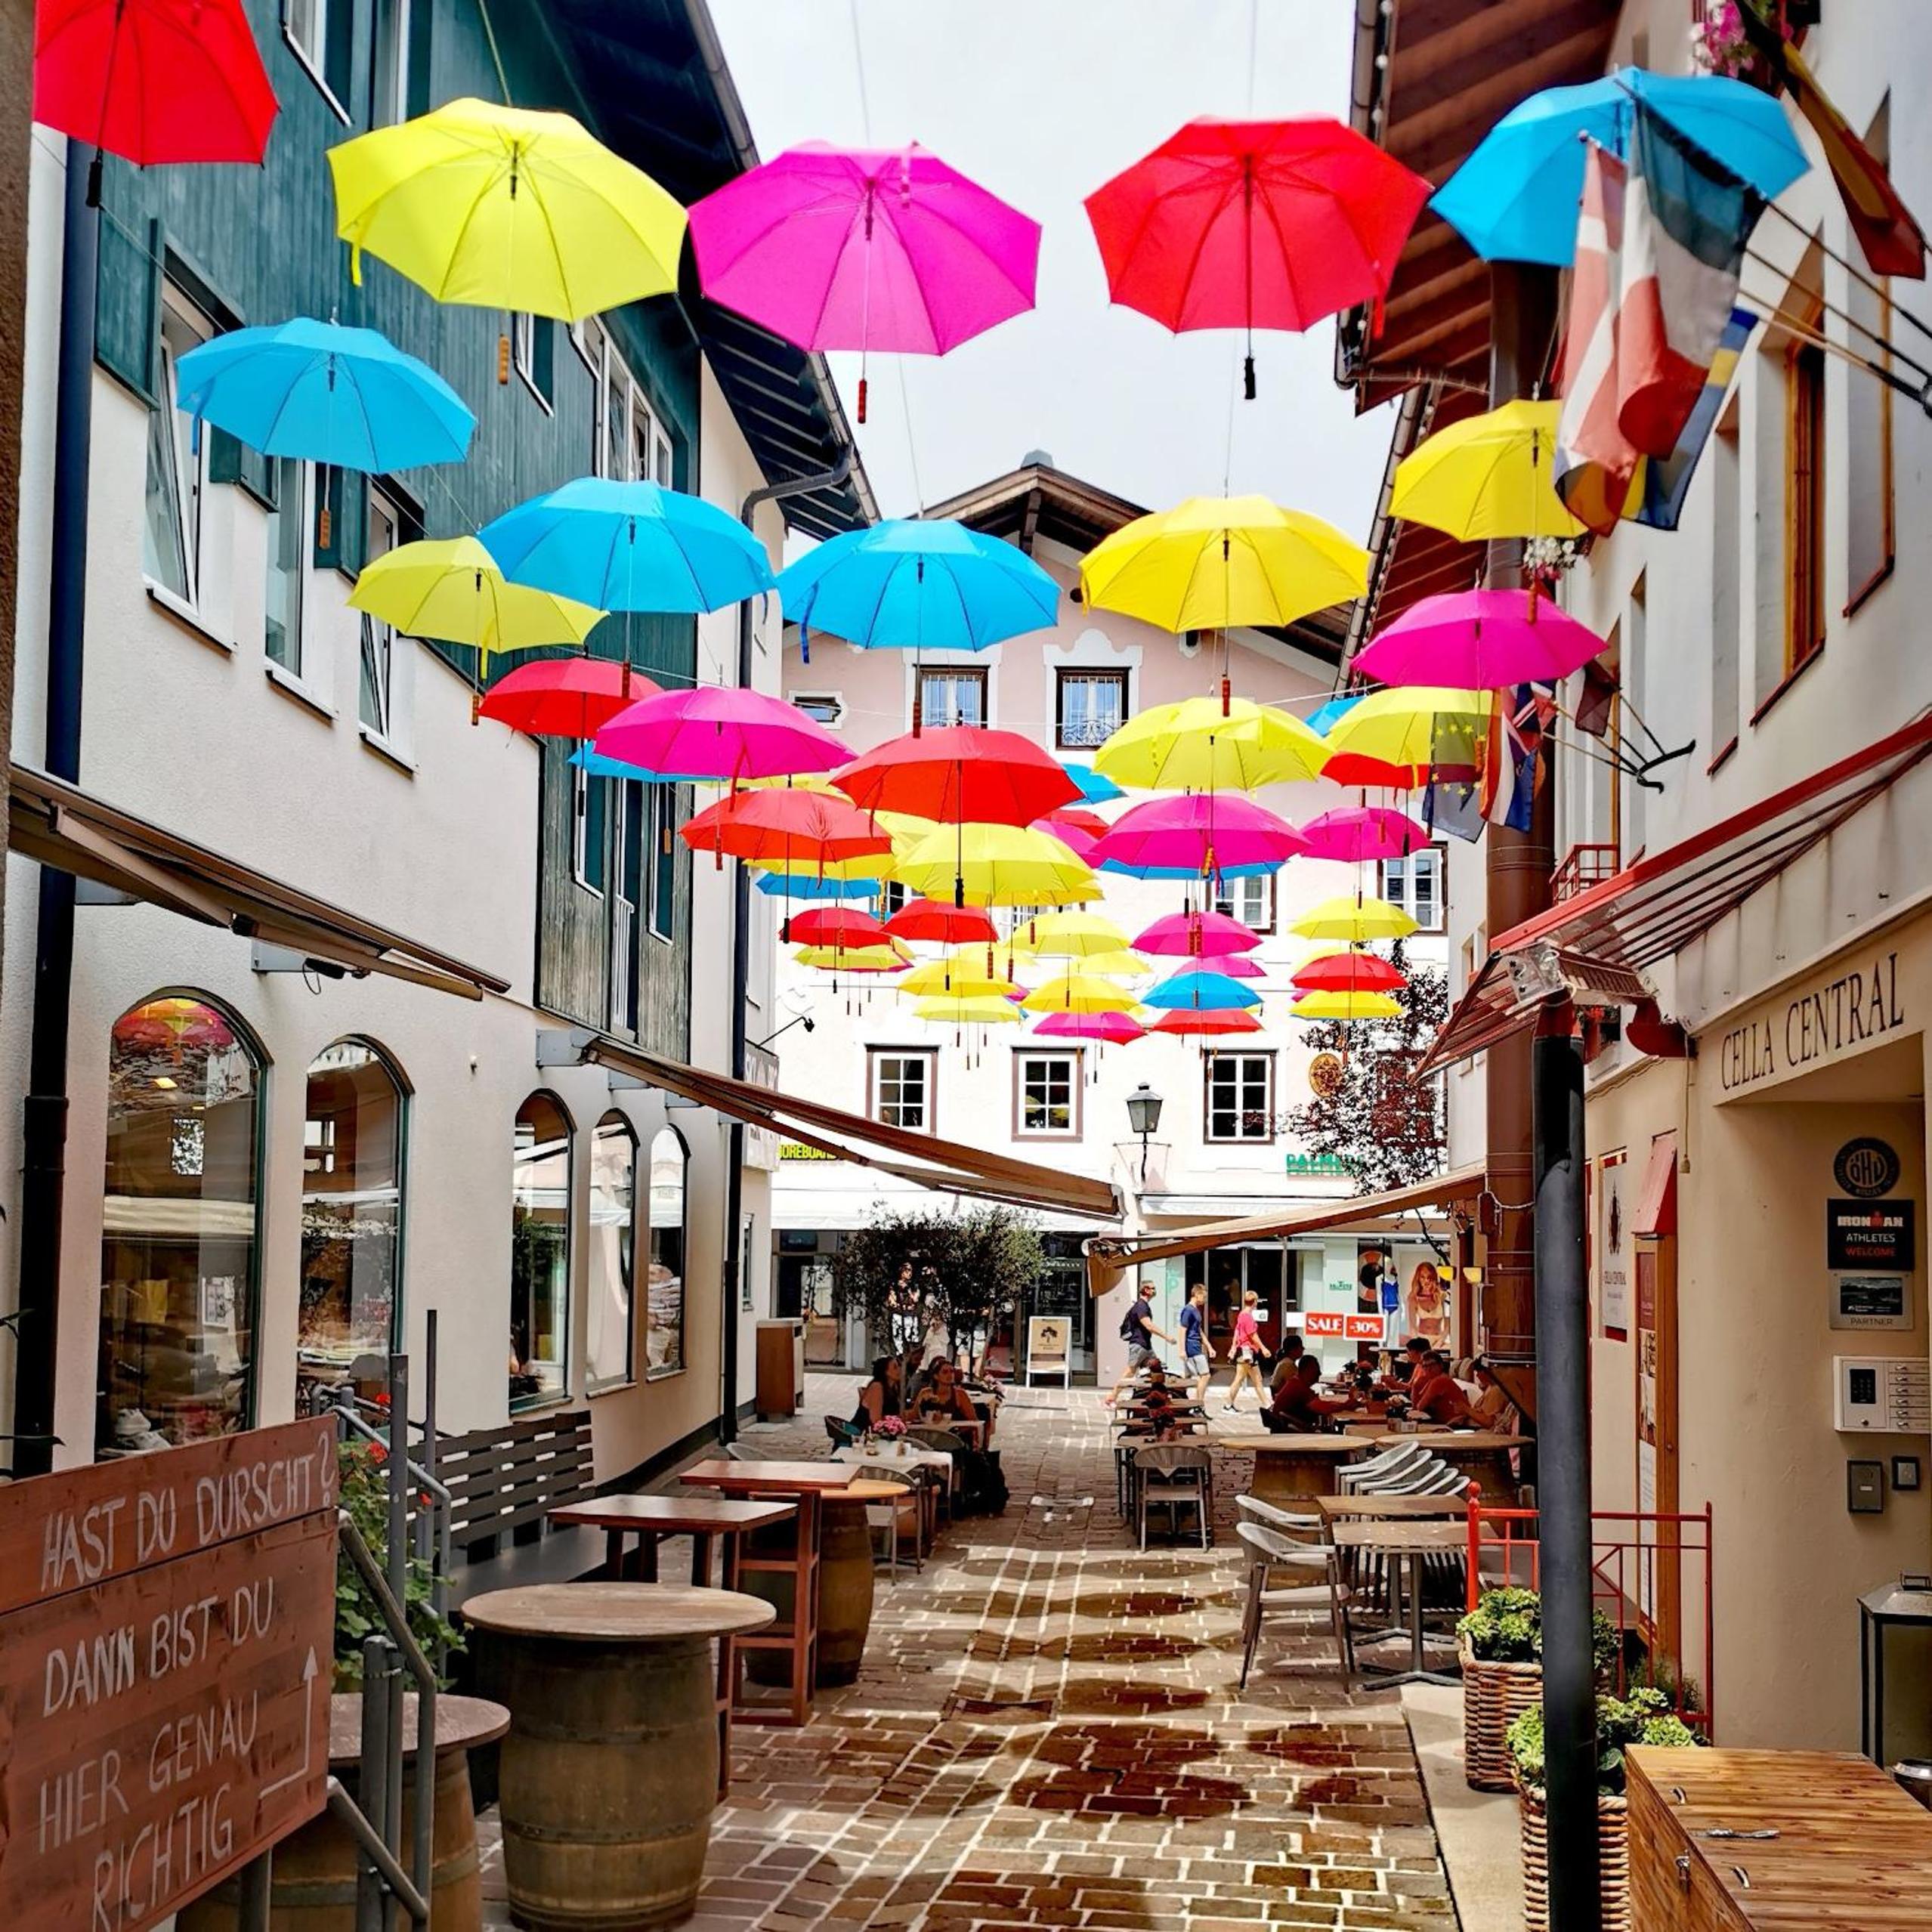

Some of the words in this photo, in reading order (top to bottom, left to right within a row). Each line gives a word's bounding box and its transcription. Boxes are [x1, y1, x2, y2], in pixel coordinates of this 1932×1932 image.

[1720, 1015, 1775, 1090] CELLA
[1785, 951, 1904, 1067] CENTRAL
[1838, 1211, 1903, 1227] IRONMAN
[1846, 1233, 1896, 1243] ATHLETES
[1845, 1247, 1896, 1257] WELCOME
[1307, 1318, 1342, 1331] SALE
[1349, 1321, 1380, 1334] -30%
[1850, 1317, 1893, 1325] PARTNER
[40, 1495, 127, 1593] HAST
[137, 1486, 177, 1564] DU
[43, 1624, 135, 1718] DANN
[150, 1595, 218, 1680] BIST
[233, 1575, 274, 1646] DU
[39, 1749, 130, 1854] HIER
[149, 1689, 258, 1793] GENAU
[92, 1782, 233, 1932] RICHTIG
